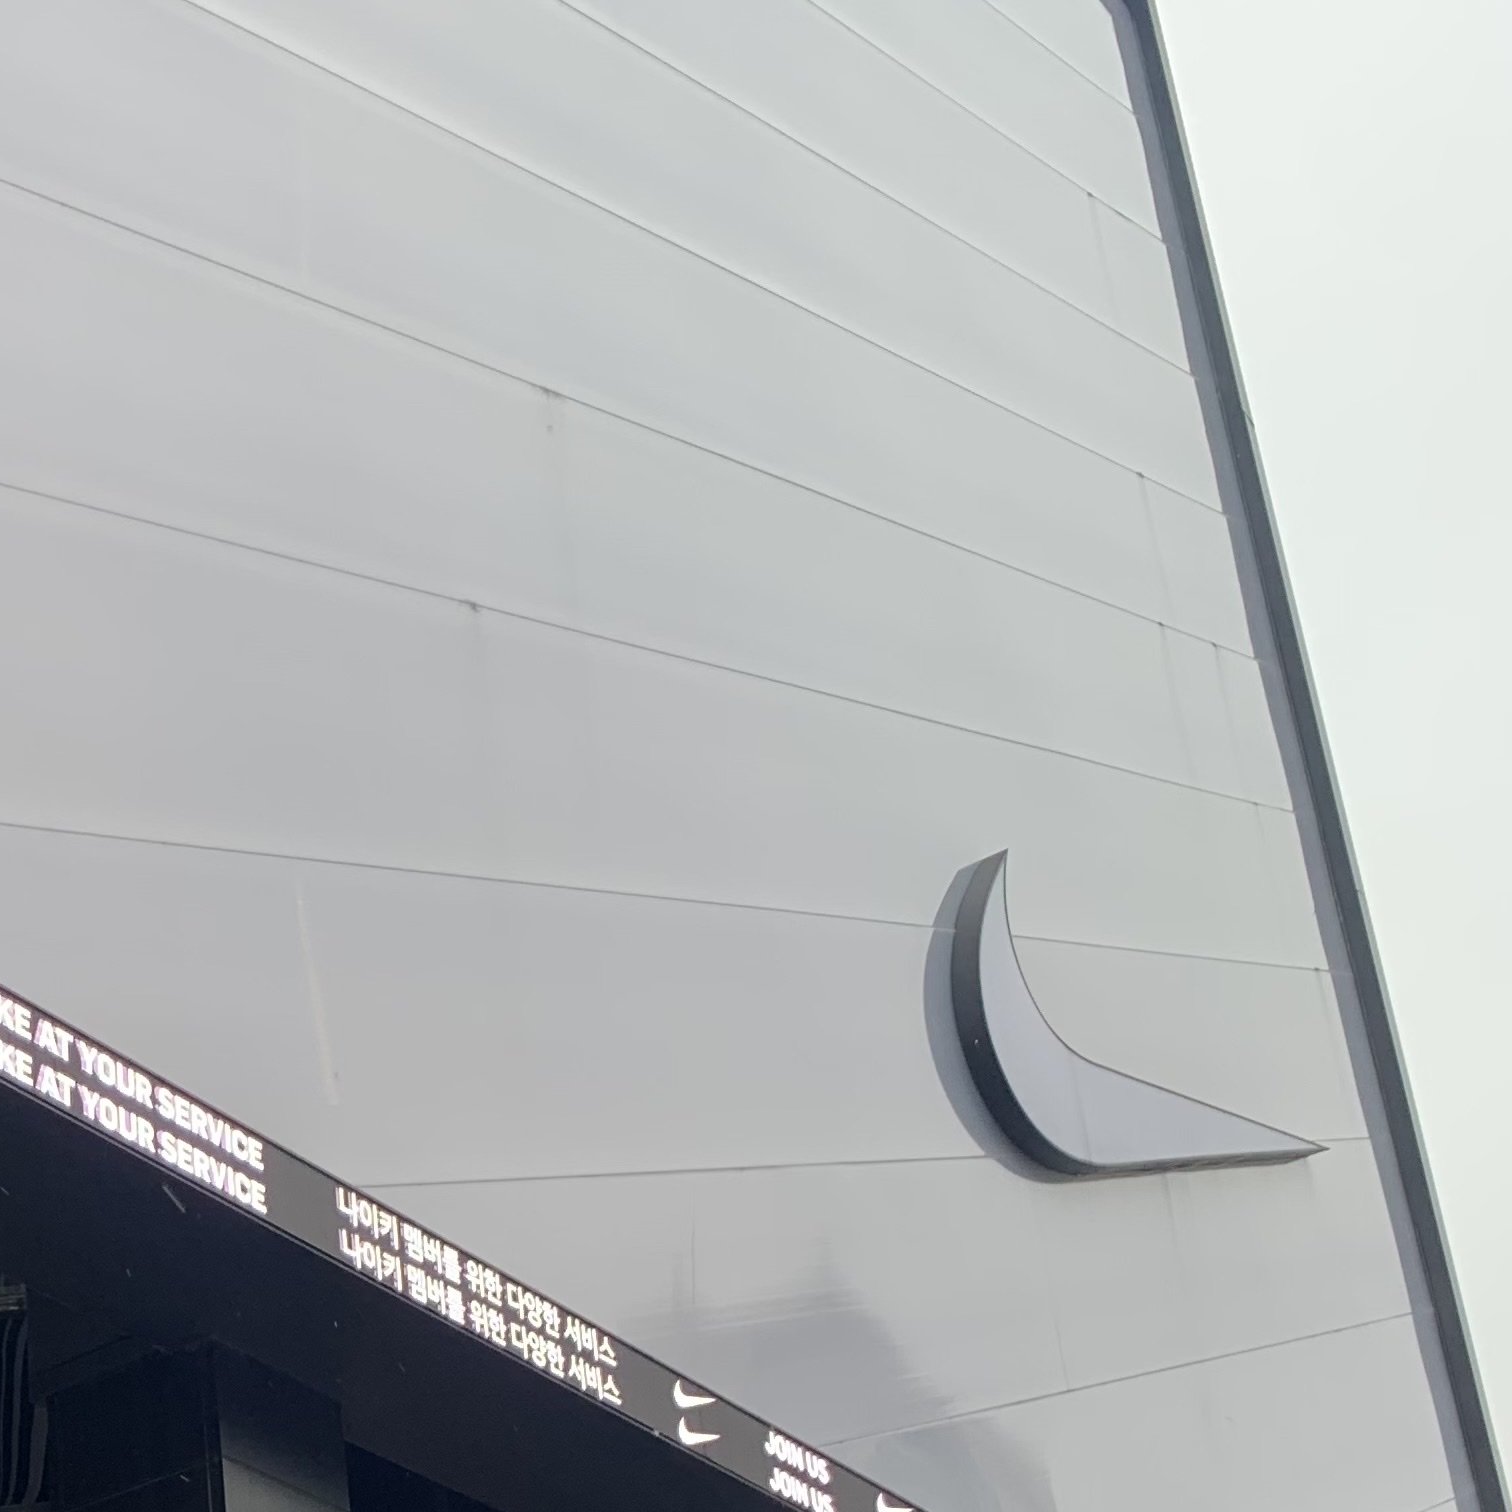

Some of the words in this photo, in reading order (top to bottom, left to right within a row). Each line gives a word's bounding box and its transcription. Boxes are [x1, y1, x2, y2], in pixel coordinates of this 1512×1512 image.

[33, 1065, 76, 1106] AT
[78, 1082, 155, 1154] YOUR
[157, 1129, 267, 1214] SERVICE
[34, 1019, 74, 1062] AT
[75, 1038, 153, 1108] YOUR
[154, 1085, 264, 1171] SERVICE
[336, 1186, 399, 1250] 나이키
[402, 1222, 462, 1284] 멤버를
[465, 1260, 502, 1306] 위한
[507, 1282, 560, 1338] 다양한
[564, 1316, 617, 1367] 서비스
[339, 1228, 402, 1292] 나이키
[407, 1264, 465, 1325] 멤버를
[469, 1300, 506, 1347] 위한
[510, 1322, 564, 1378] 다양한
[568, 1355, 622, 1405] 서비스
[765, 1431, 803, 1471] JOIN
[805, 1452, 830, 1484] US
[770, 1467, 808, 1508] JOIN
